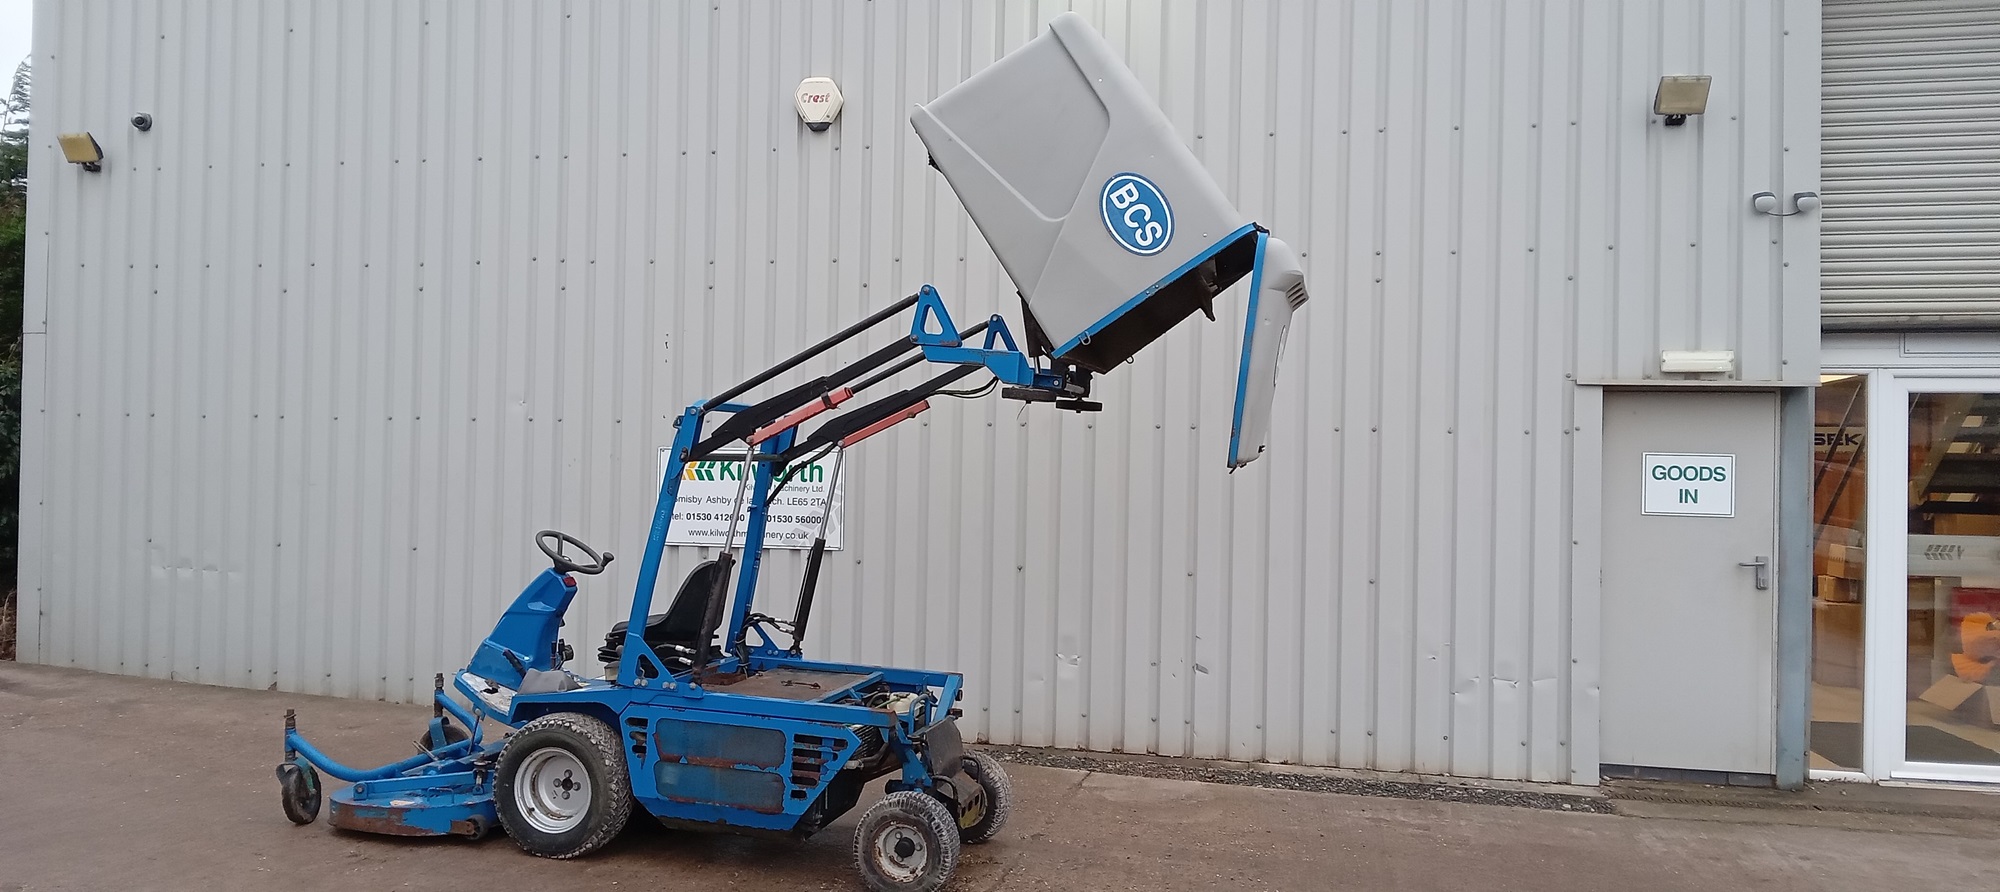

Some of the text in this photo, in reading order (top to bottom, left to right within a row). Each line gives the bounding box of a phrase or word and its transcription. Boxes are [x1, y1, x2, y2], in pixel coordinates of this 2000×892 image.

[801, 92, 830, 103] Crest
[1109, 182, 1162, 246] BCS
[1652, 465, 1726, 481] GOODS
[706, 495, 732, 506] Ashby
[787, 498, 808, 506] LE65
[811, 498, 827, 506] 2TA
[1679, 489, 1698, 503] IN
[686, 512, 712, 521] 01530
[767, 515, 793, 523] 01530
[795, 516, 824, 524] 56000
